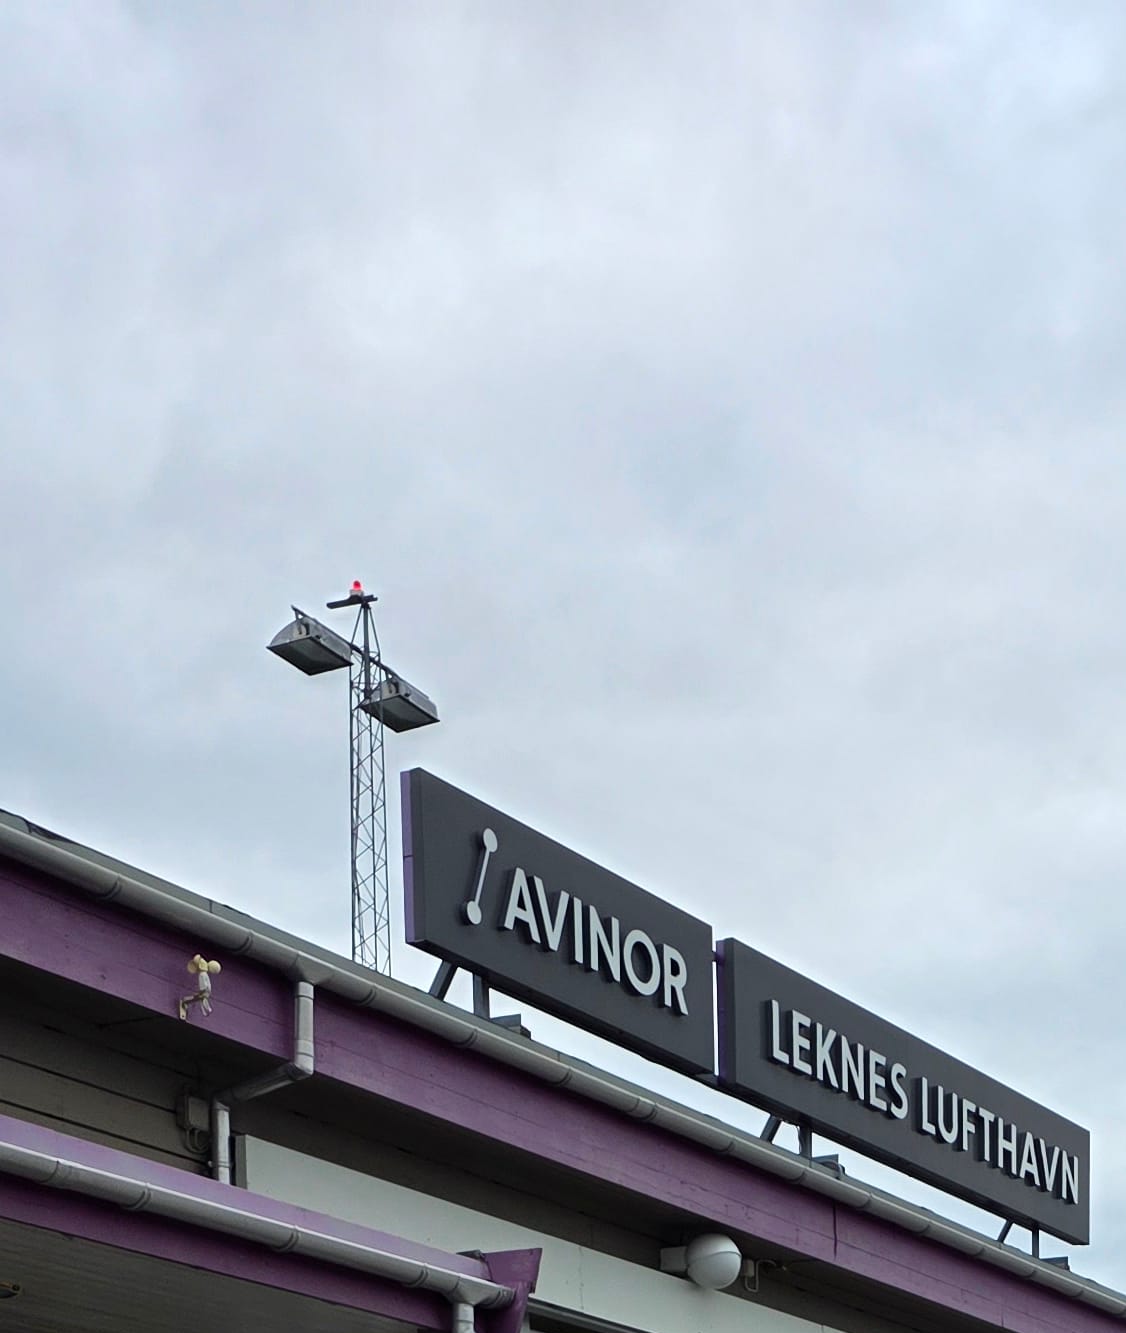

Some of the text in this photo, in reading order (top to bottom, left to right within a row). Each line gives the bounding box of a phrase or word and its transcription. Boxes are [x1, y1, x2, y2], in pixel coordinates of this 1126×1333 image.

[502, 866, 689, 1016] AVINOR
[770, 999, 1080, 1206] LEKNES LUFTHAVN
